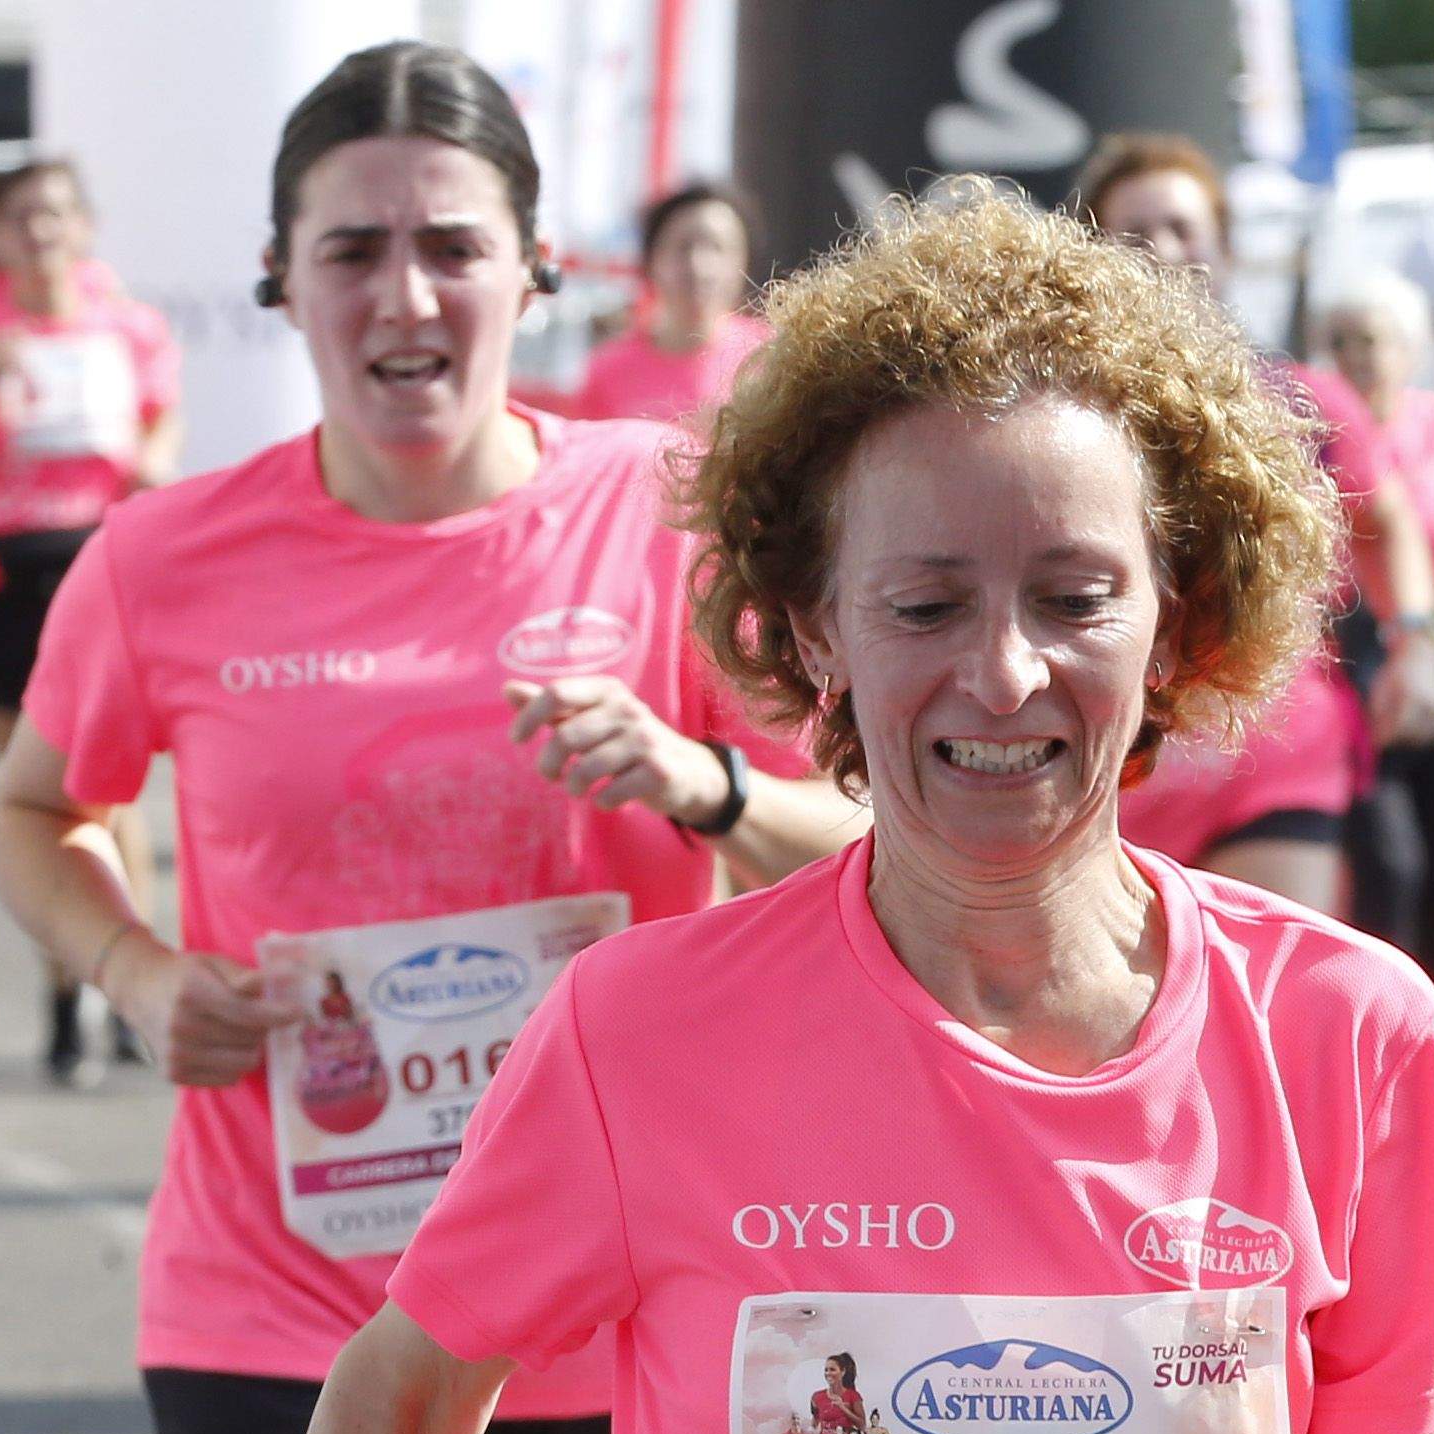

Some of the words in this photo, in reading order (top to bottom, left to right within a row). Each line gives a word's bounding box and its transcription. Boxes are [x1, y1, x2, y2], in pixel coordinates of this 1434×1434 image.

[219, 650, 377, 695] OYSHO
[732, 1202, 955, 1250] OYSHO
[1152, 1346, 1174, 1360] TU
[1178, 1342, 1249, 1359] DORSAL
[947, 1377, 1024, 1389] CENTRAL
[1031, 1377, 1108, 1389] LECHERA
[1153, 1359, 1247, 1387] SUMA
[910, 1379, 1115, 1421] ASTURIANA
